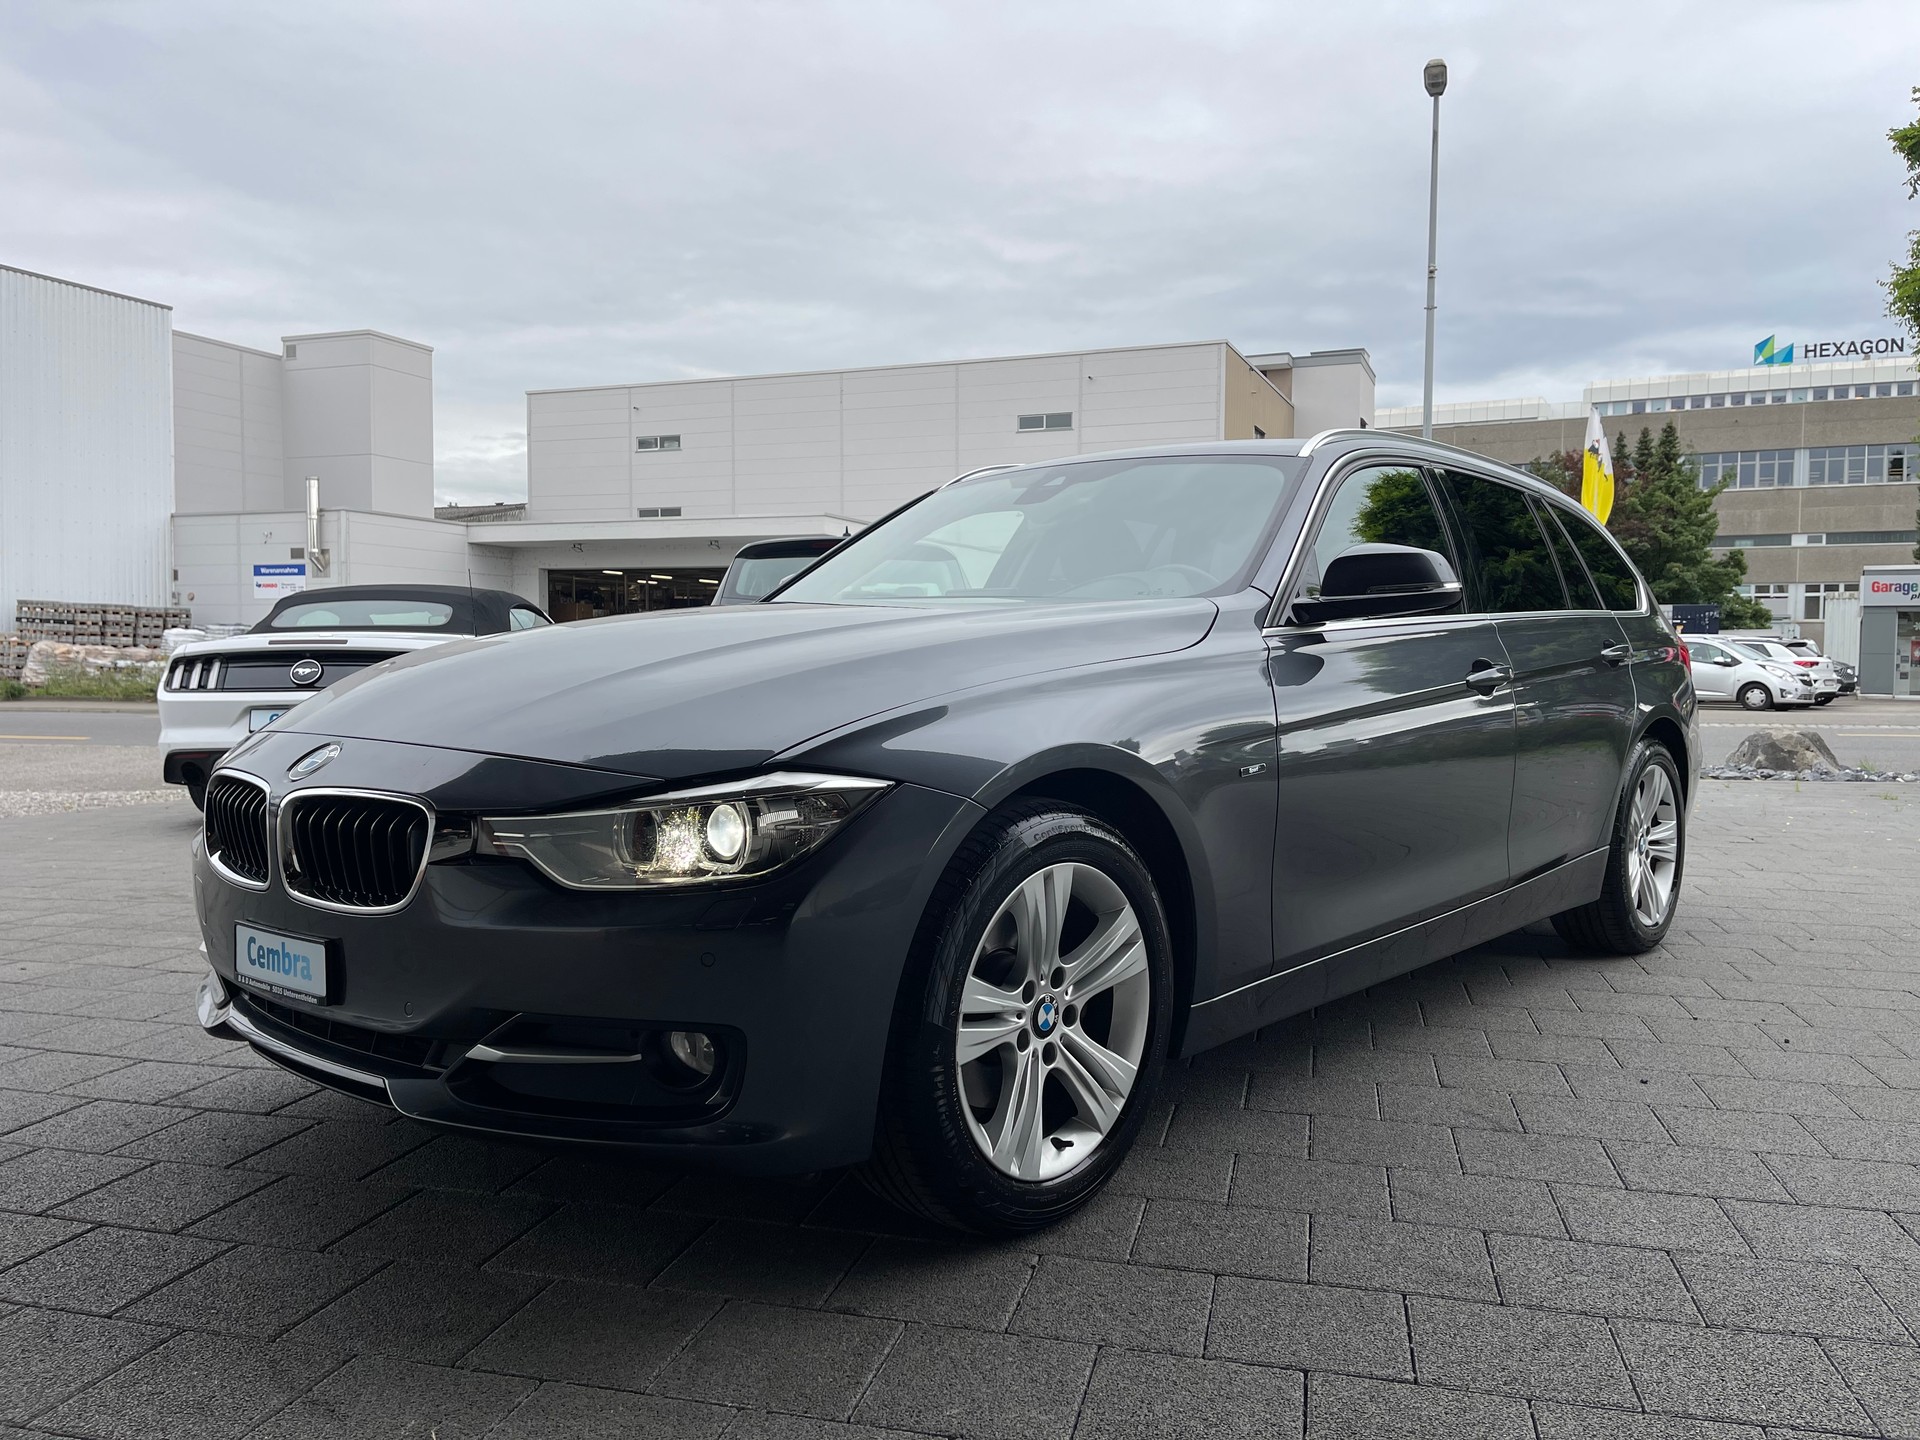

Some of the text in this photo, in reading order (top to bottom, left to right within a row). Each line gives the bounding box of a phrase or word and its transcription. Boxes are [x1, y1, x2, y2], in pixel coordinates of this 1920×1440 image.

[1804, 337, 1904, 358] HEXAGON
[1871, 581, 1919, 595] Garage
[247, 936, 312, 980] Cembra
